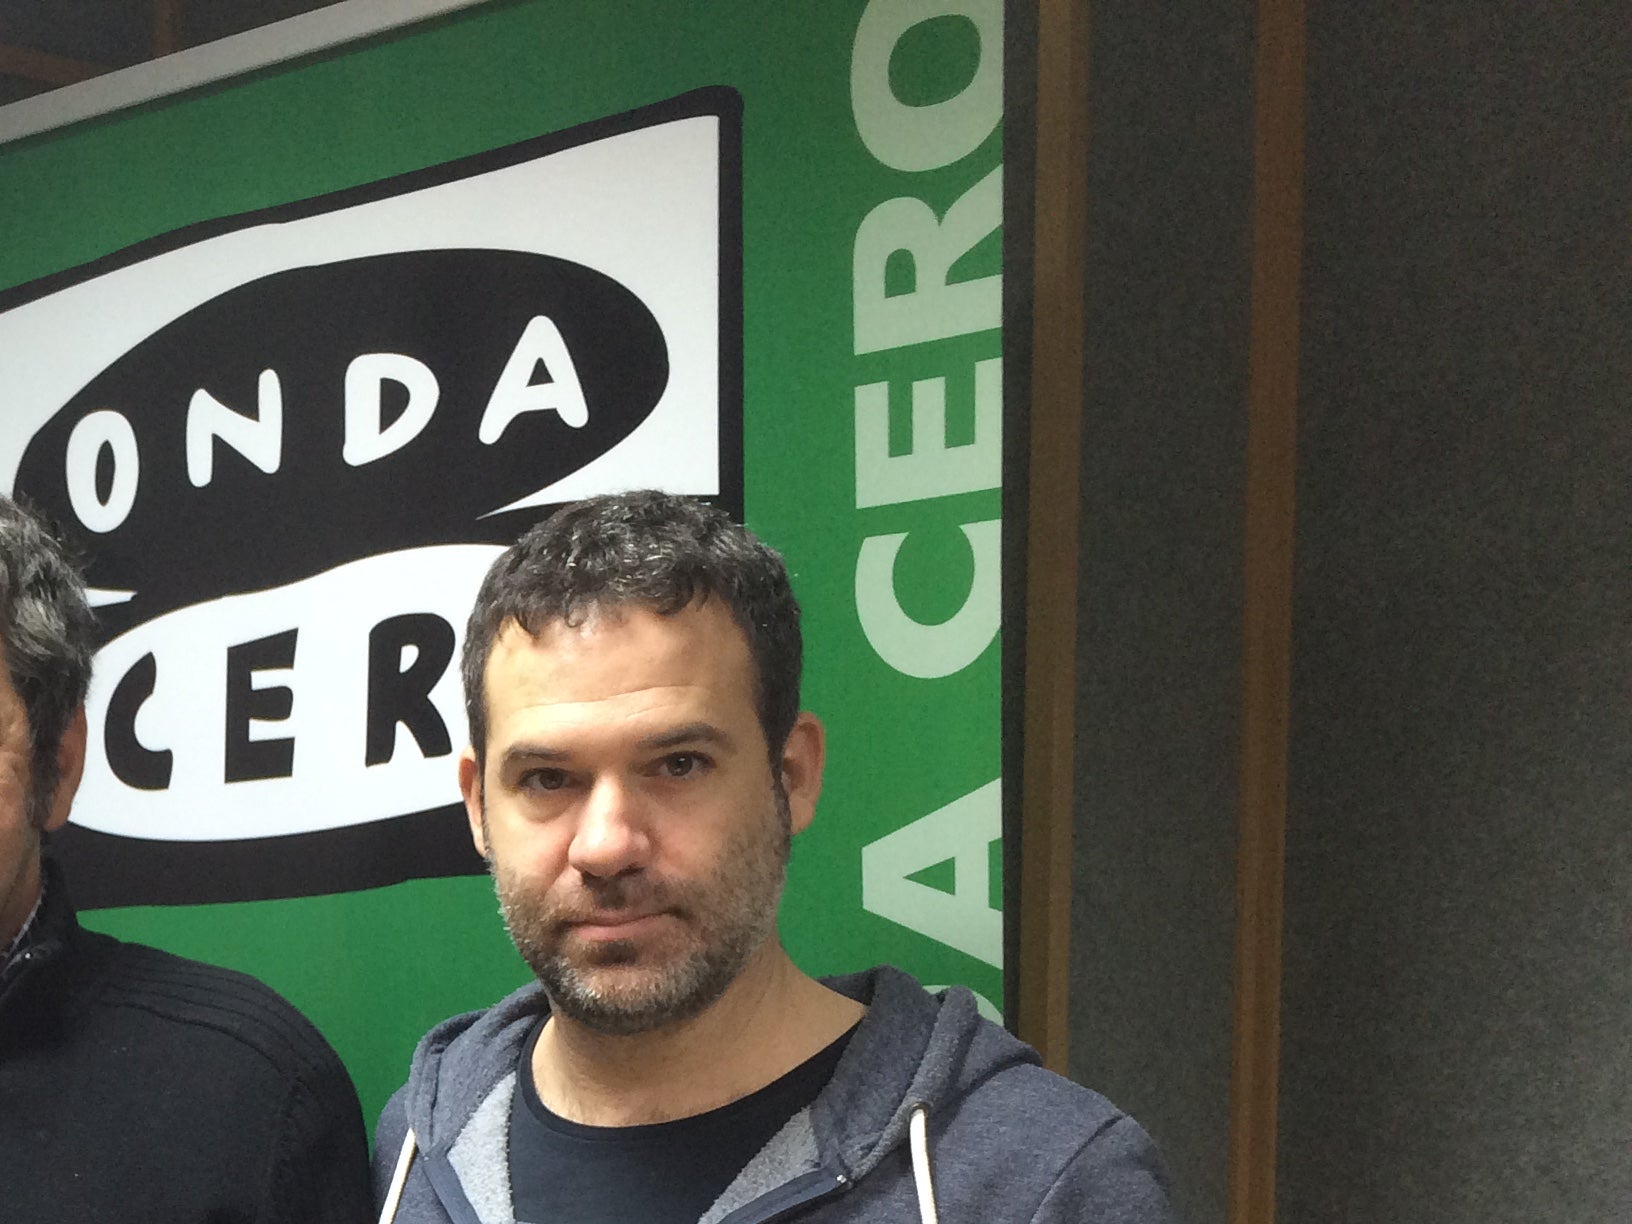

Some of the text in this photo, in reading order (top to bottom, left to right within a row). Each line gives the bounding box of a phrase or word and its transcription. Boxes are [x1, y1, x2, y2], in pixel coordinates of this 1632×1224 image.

[66, 315, 589, 533] ONDA
[850, 0, 1004, 679] CERO
[104, 612, 457, 790] CER
